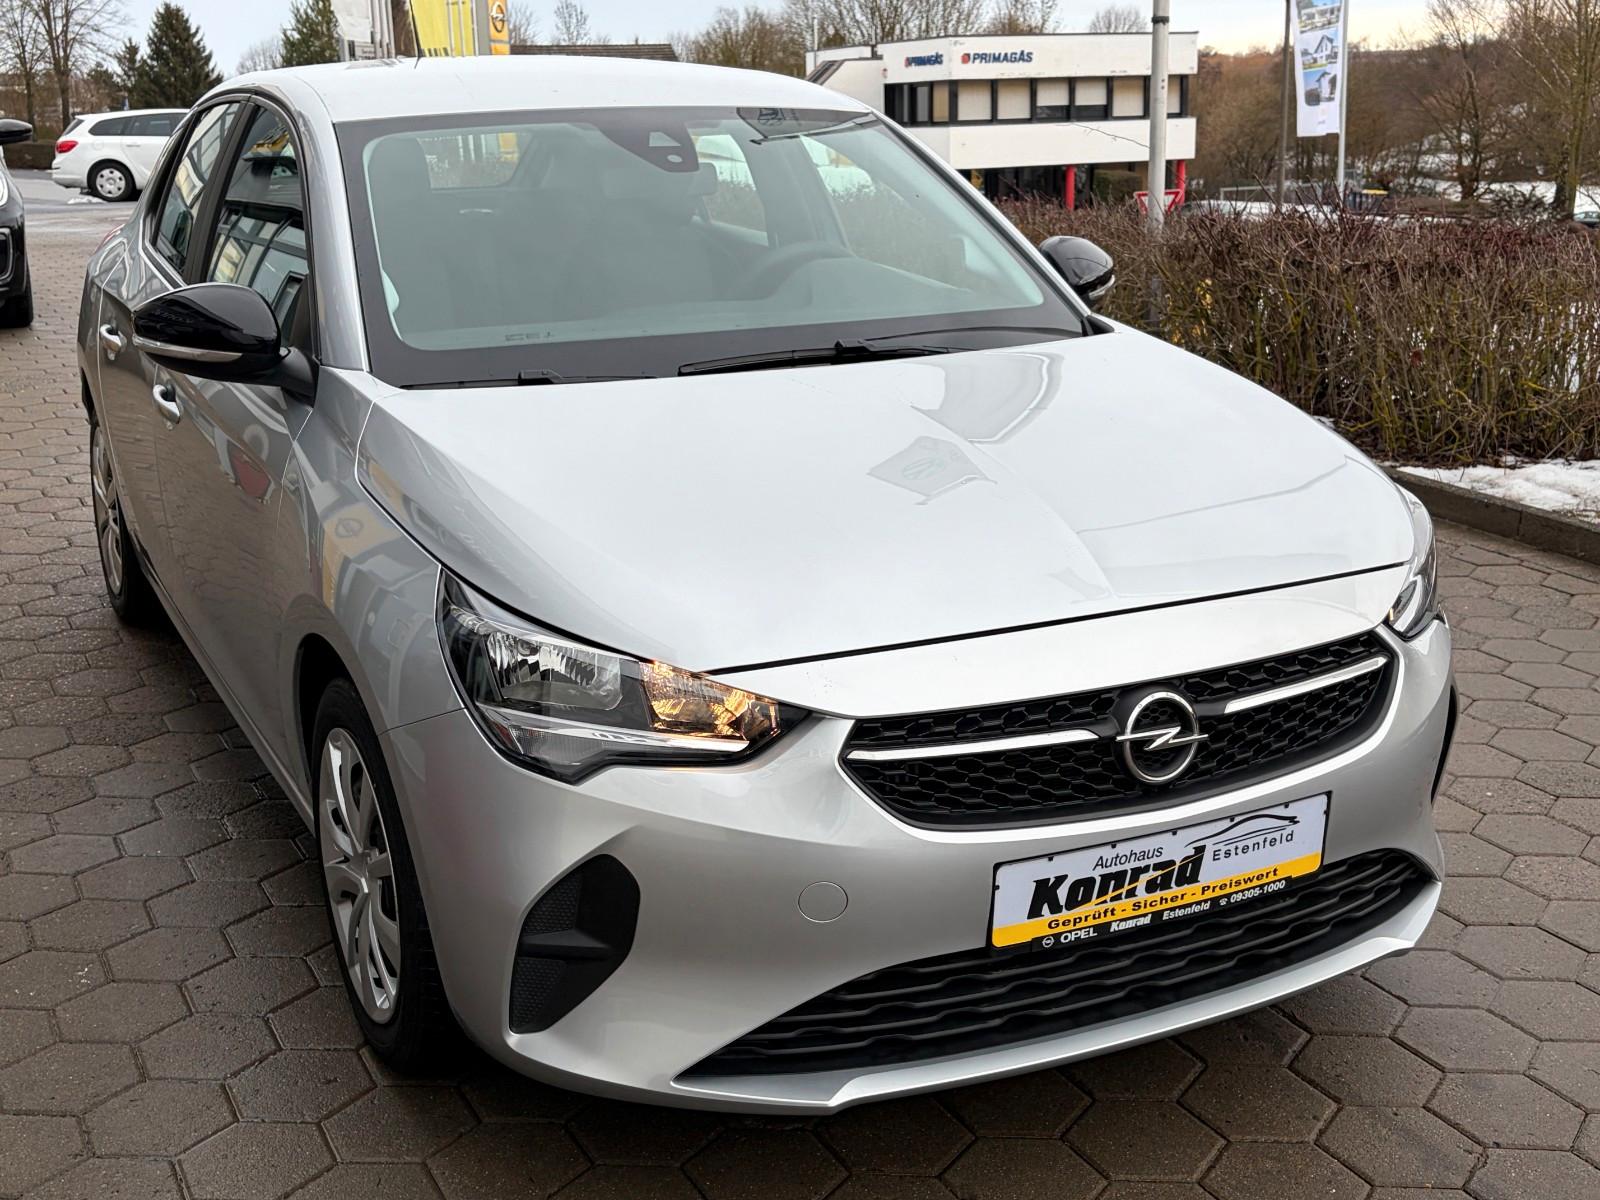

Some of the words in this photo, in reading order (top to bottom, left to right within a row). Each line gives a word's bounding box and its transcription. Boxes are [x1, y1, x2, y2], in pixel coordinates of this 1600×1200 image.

[1092, 847, 1164, 871] Autohaus
[1212, 830, 1295, 861] Estenfeld
[1026, 844, 1207, 920] Konrad
[1047, 907, 1117, 930] Geprüft
[1132, 892, 1187, 912] Sicher
[1200, 868, 1279, 896] Preiswert
[1060, 928, 1098, 944] OPEL
[1109, 914, 1152, 932] Konrad
[1162, 901, 1211, 921] Estenfeld
[1229, 880, 1286, 903] 09305-1000
